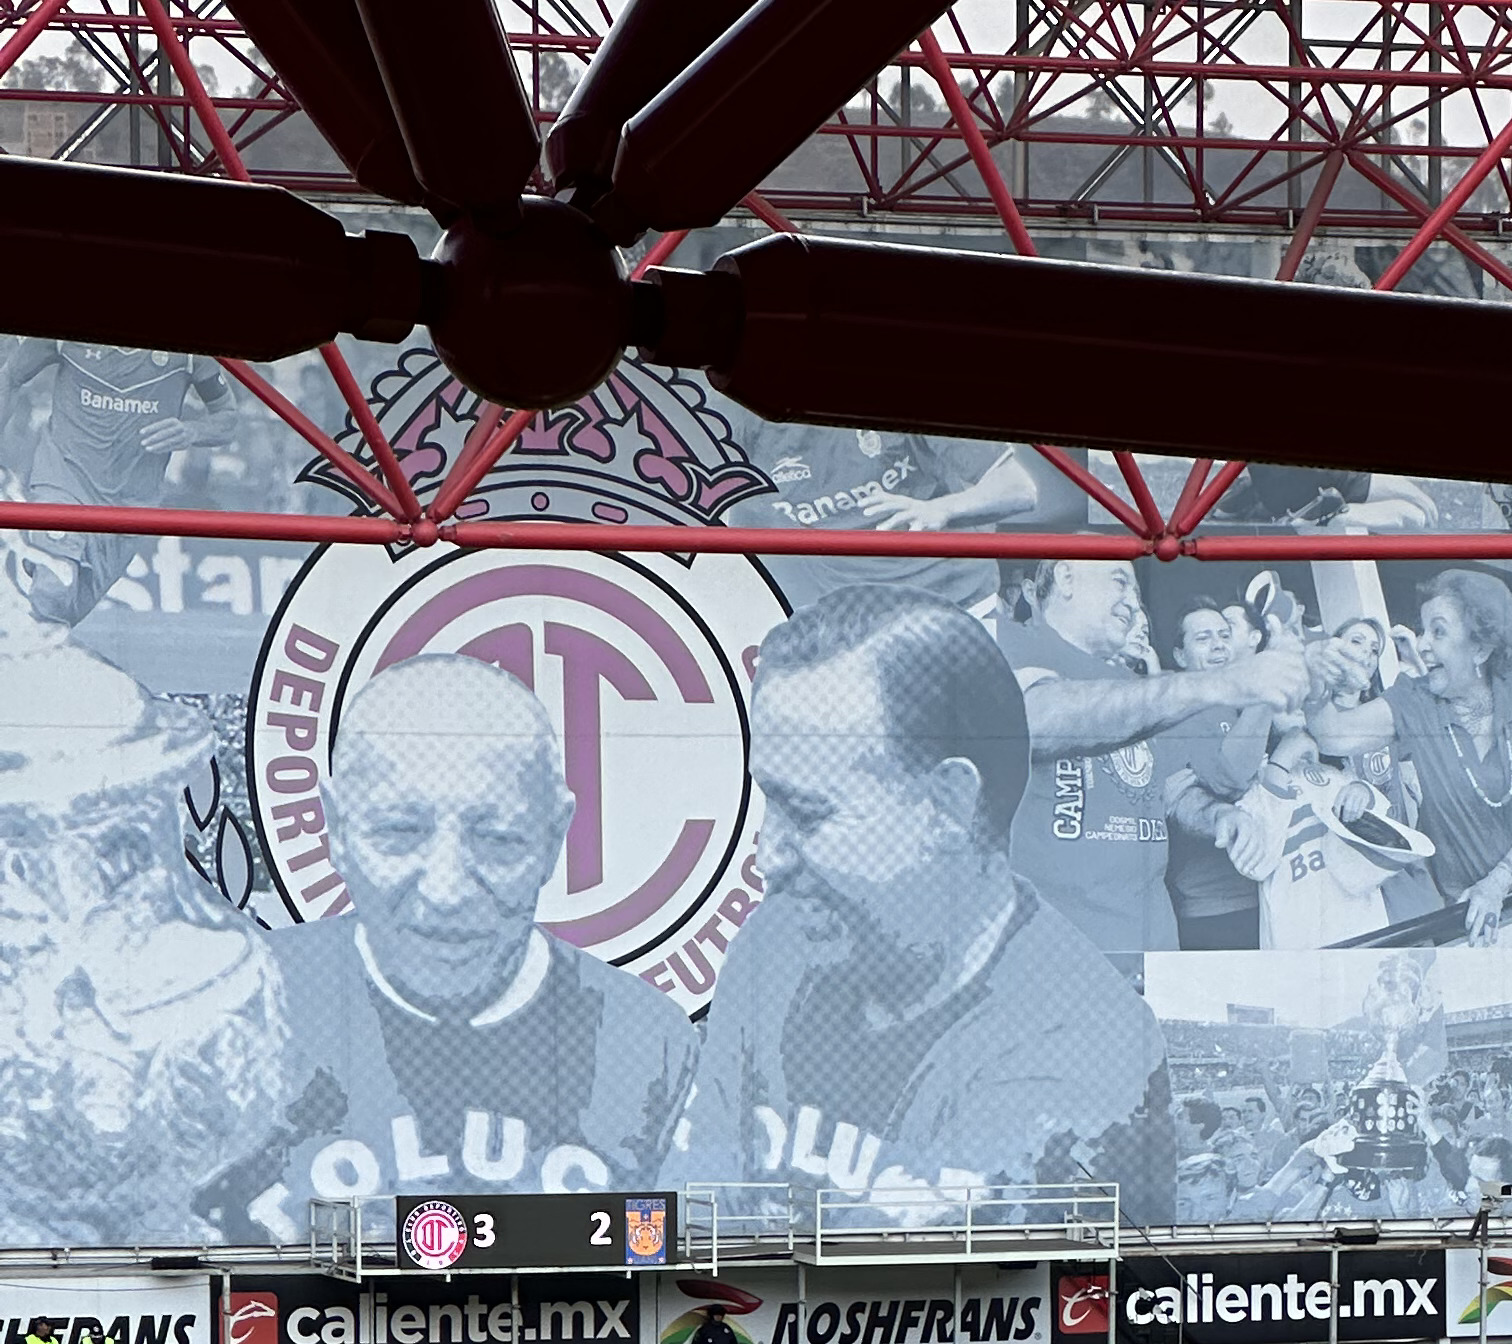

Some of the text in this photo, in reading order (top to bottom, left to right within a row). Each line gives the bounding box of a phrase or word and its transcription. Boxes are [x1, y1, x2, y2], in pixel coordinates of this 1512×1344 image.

[80, 388, 159, 414] Banamex
[473, 1213, 496, 1248] 3
[589, 1211, 613, 1246] 2
[1125, 1273, 1438, 1325] caliente.mx
